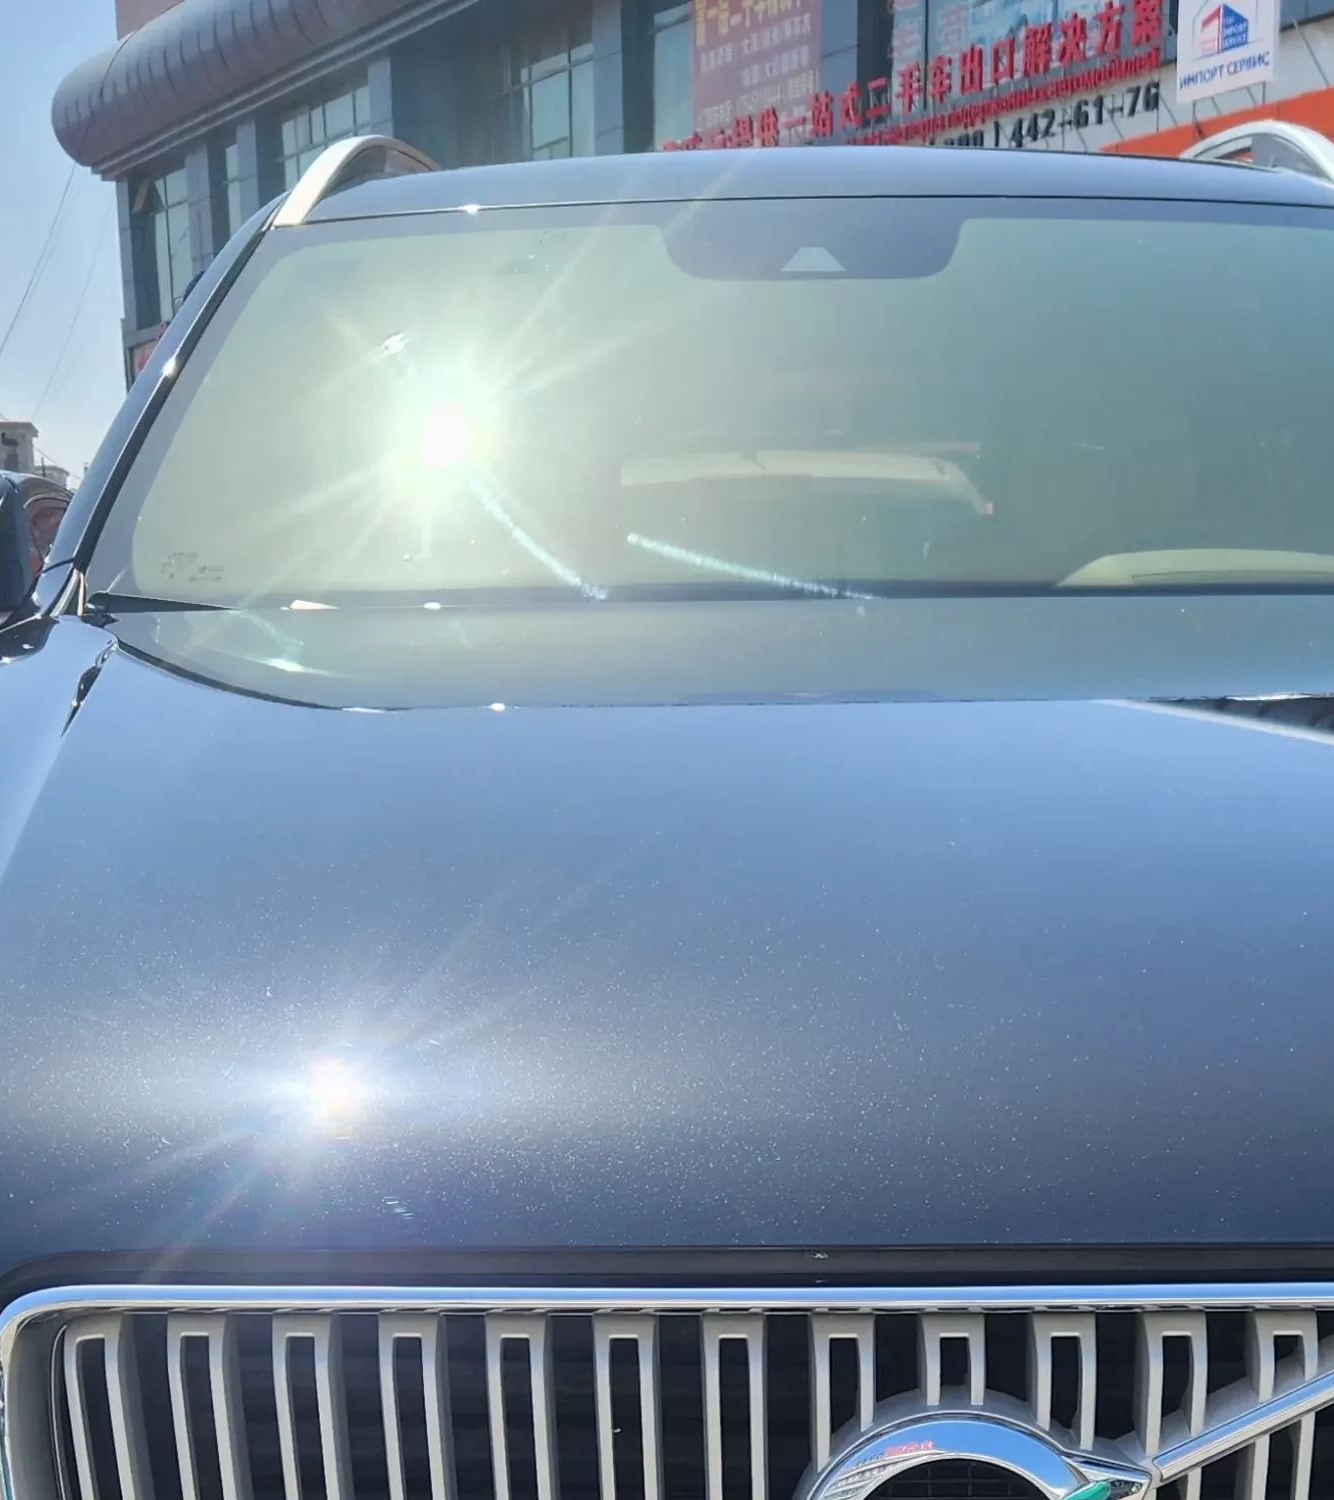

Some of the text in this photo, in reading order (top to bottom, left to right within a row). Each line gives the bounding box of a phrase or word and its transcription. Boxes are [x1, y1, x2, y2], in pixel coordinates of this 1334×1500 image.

[1048, 44, 1160, 99] автомобилей
[1179, 51, 1270, 90] ИМПОРТ СЕРВИС
